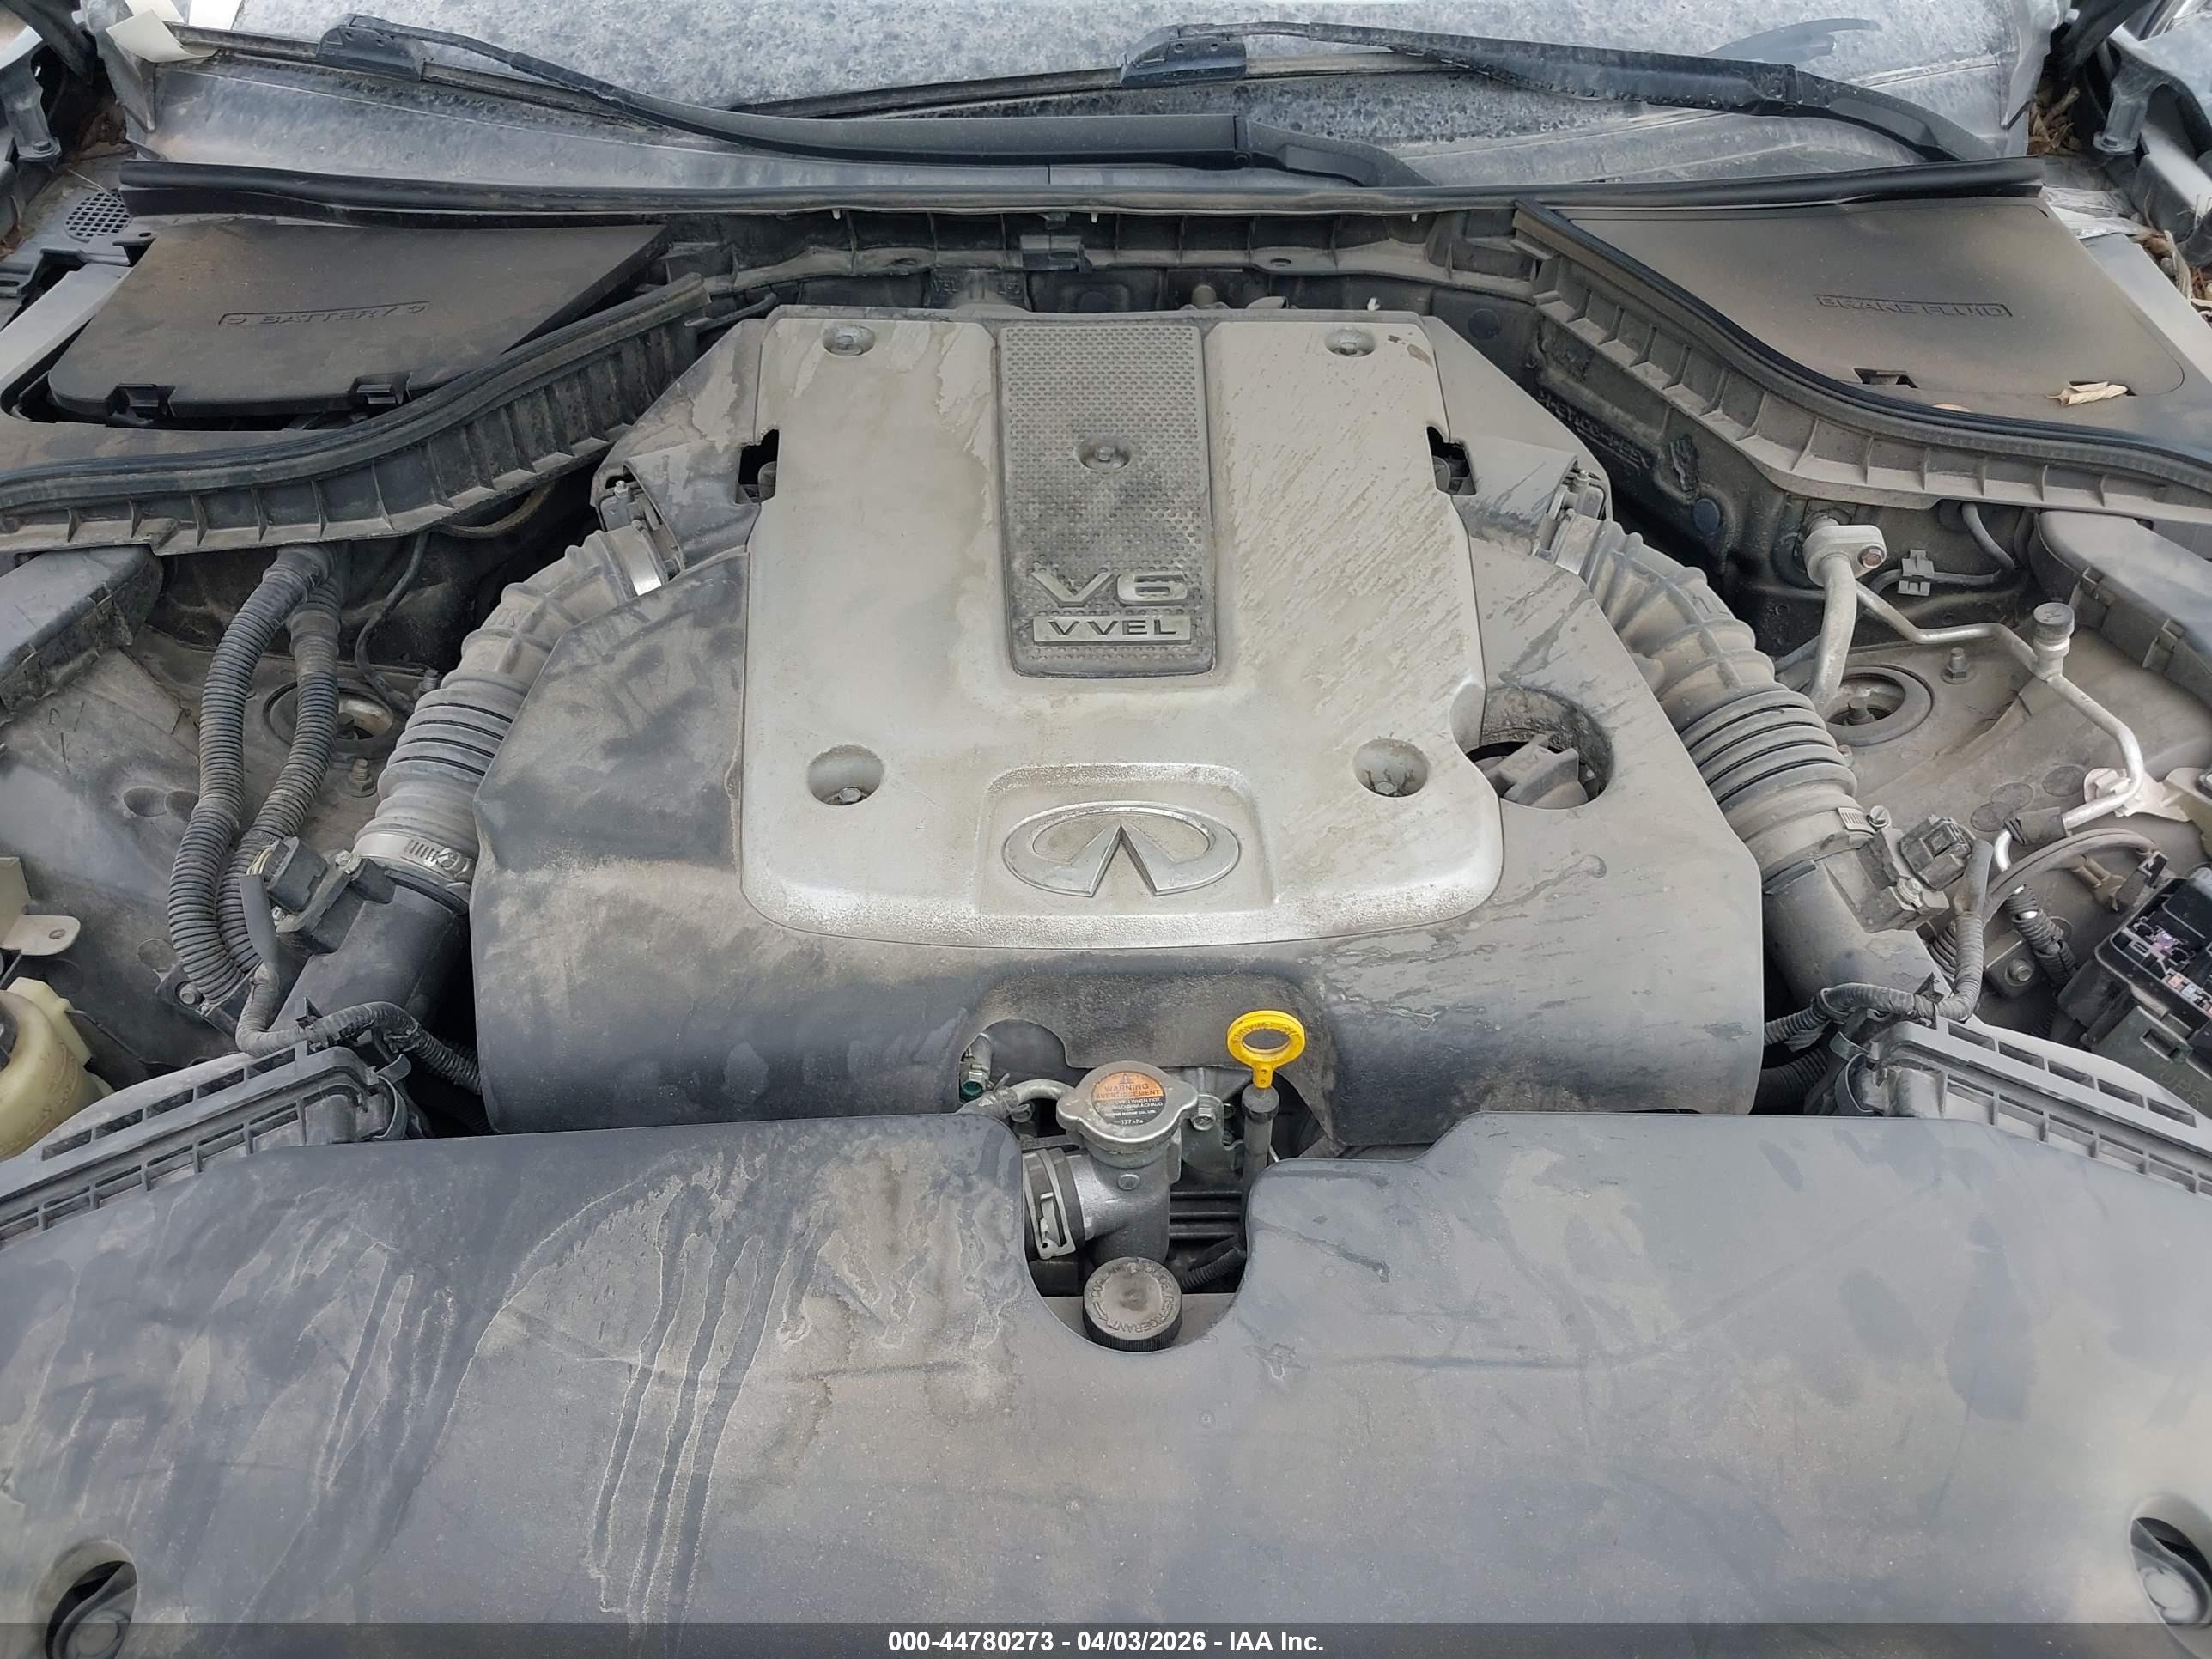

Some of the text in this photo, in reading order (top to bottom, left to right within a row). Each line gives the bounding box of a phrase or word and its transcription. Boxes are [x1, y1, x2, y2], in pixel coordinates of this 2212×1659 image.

[1816, 296, 2004, 316] BRAKE FLUID
[259, 307, 398, 324] BATTERY
[1031, 570, 1188, 607] V6
[1048, 619, 1177, 636] VVEL
[1104, 1083, 1149, 1092] WARNING
